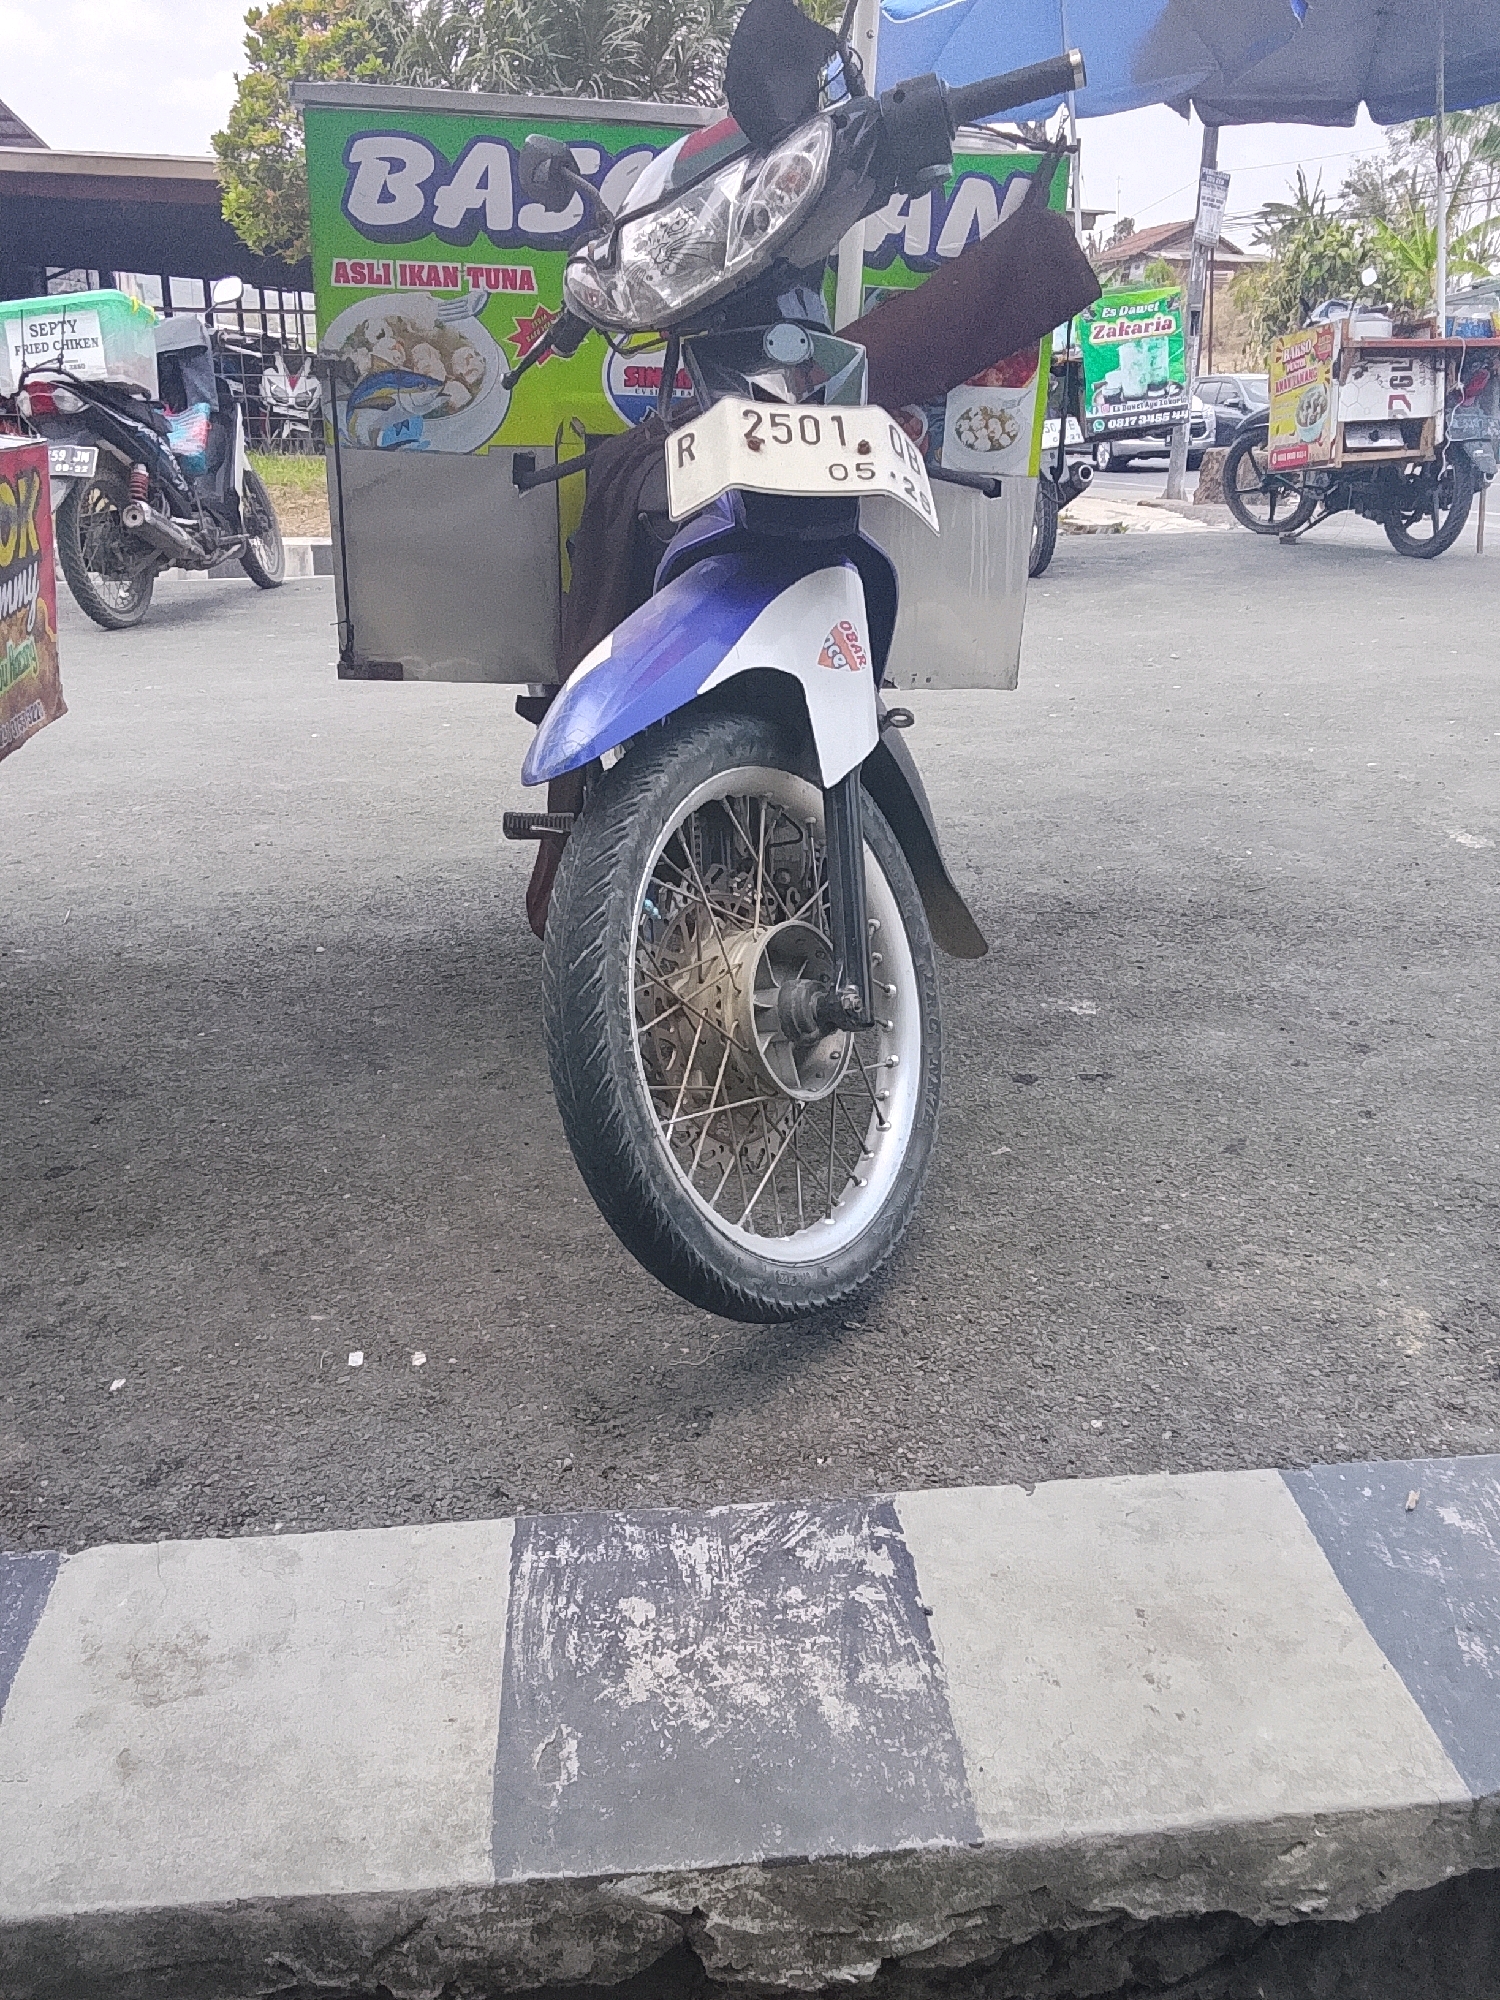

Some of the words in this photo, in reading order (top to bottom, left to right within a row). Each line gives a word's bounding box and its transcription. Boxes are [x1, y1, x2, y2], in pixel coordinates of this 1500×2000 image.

[830, 177, 1032, 258] AN
[333, 261, 392, 286] ASLI
[399, 263, 460, 288] IKAN
[466, 265, 536, 291] TUNA
[1102, 306, 1116, 318] Es
[29, 319, 77, 337] SEPTY
[1092, 316, 1173, 340] Zakaria
[15, 342, 49, 356] FRIED
[53, 337, 99, 351] CHIKEN
[624, 366, 693, 390] SINA
[677, 432, 696, 468] R
[742, 408, 847, 448] 2501
